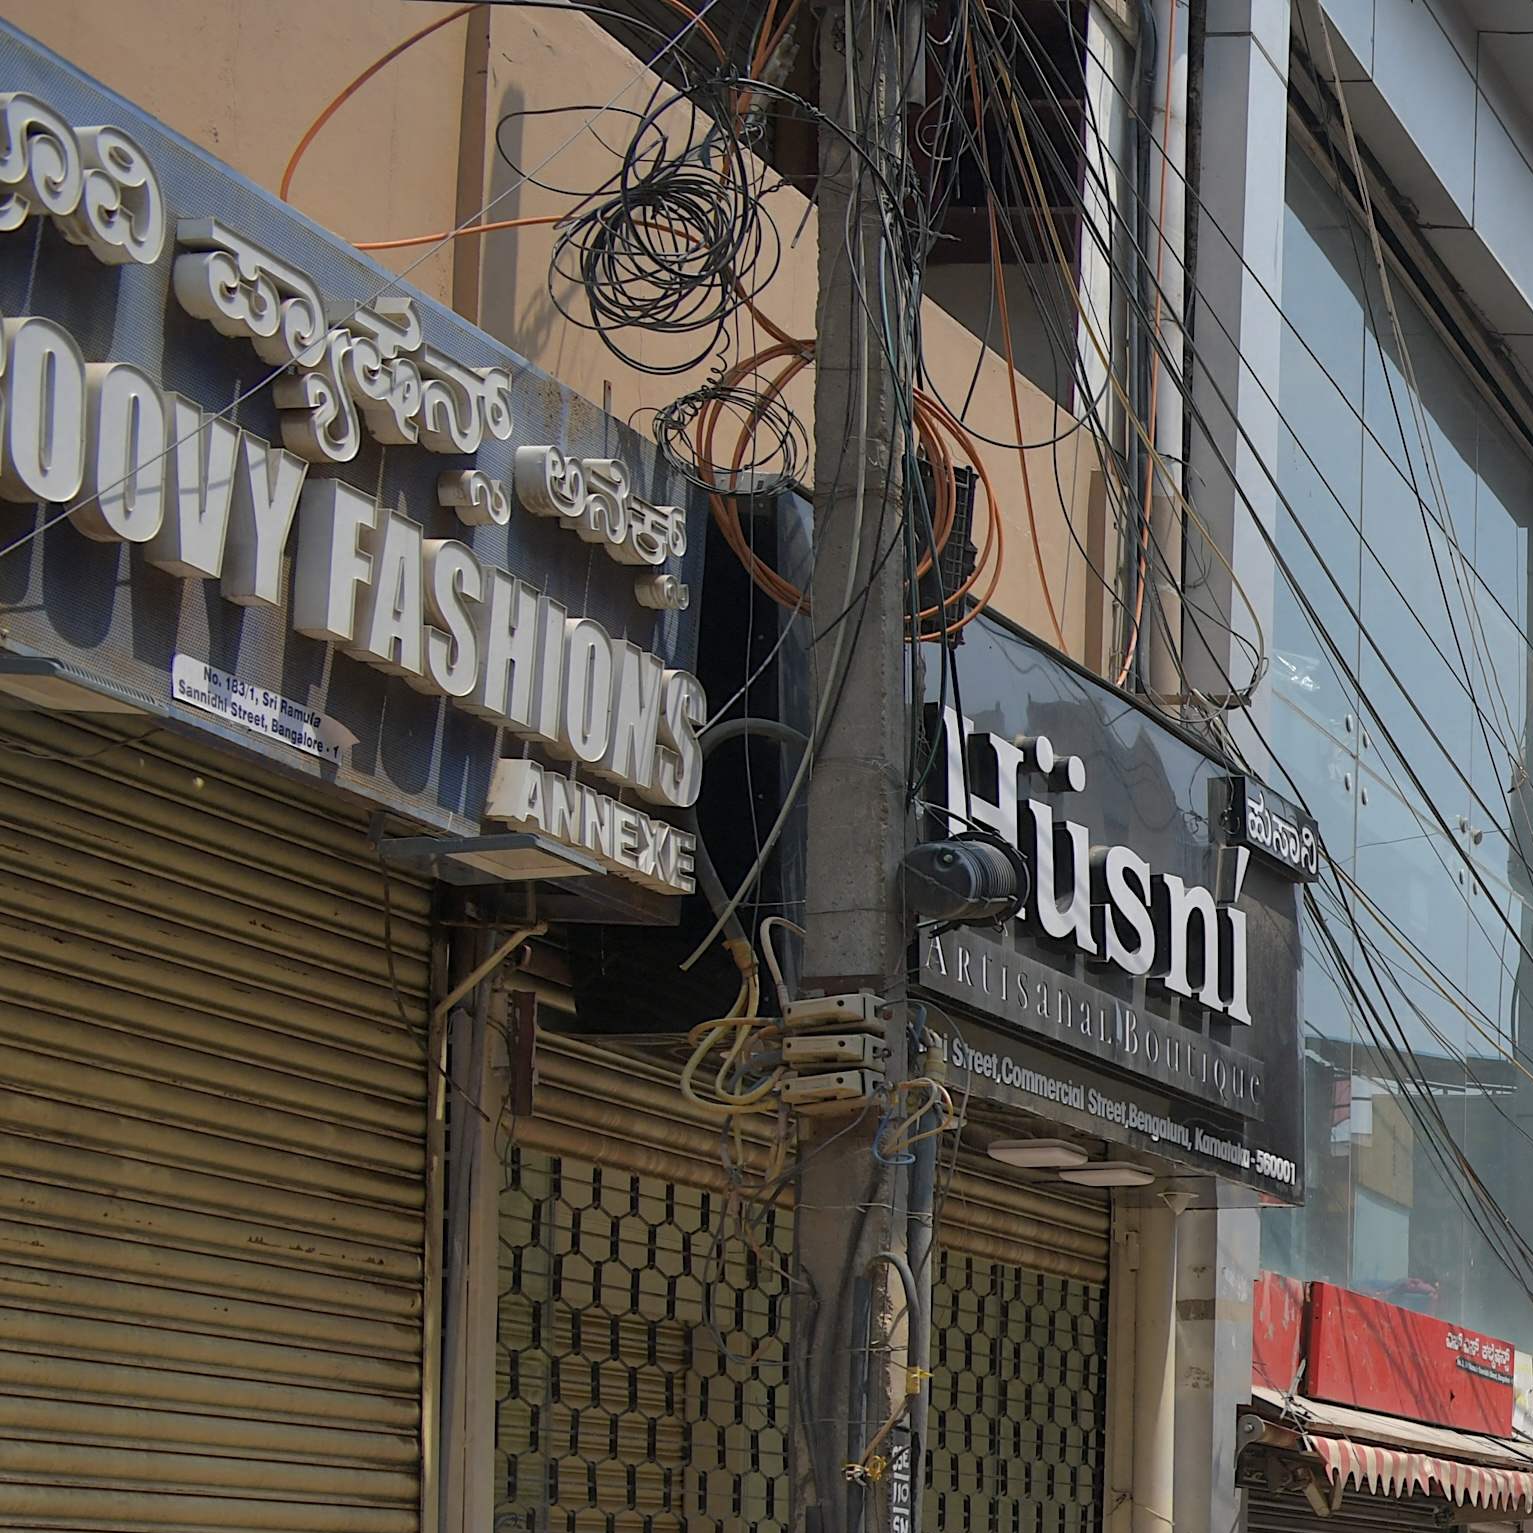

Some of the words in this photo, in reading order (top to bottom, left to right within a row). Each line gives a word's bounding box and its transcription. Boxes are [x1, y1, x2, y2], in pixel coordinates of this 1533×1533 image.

[0, 316, 309, 606] OOVY
[296, 478, 706, 807] FASHIONS
[178, 679, 228, 713] Sannidhi
[230, 701, 270, 733] Street,
[271, 718, 324, 753] Bangalore
[203, 666, 222, 688] No.
[225, 677, 260, 706] 183/1,
[262, 691, 278, 711] Sri
[280, 699, 322, 729] Ramula
[487, 757, 698, 895] ANNEXE
